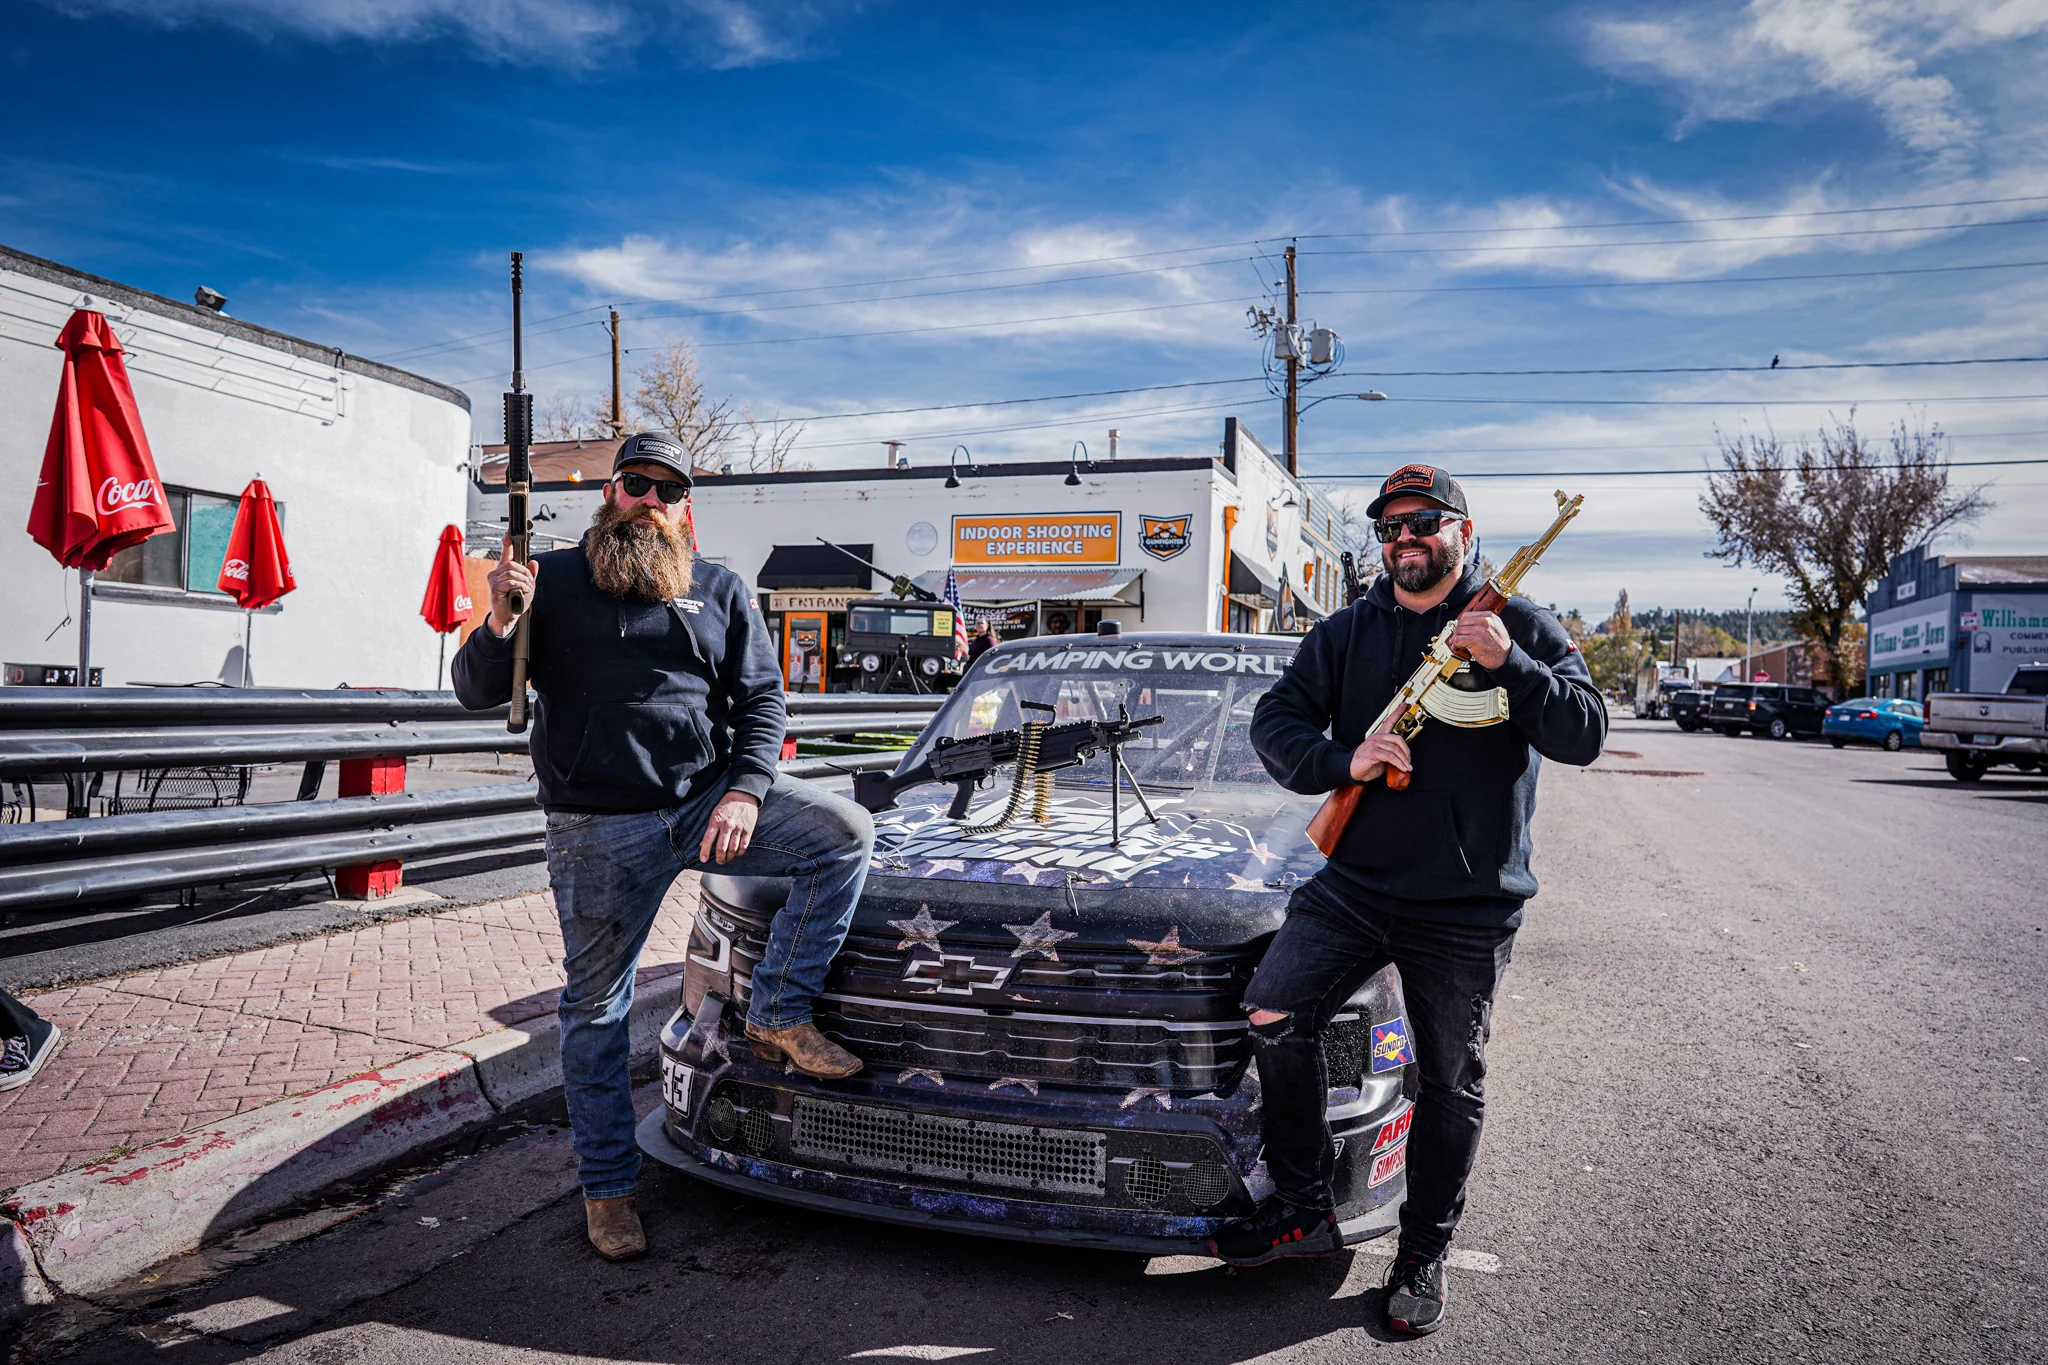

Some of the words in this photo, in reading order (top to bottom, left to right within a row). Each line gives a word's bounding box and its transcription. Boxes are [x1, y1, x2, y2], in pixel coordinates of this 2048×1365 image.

[960, 526, 1022, 540] INDOOR
[1026, 524, 1113, 539] SHOOTING
[986, 541, 1083, 555] EXPERIENCE
[985, 651, 1154, 674] CAMPING
[1161, 651, 1284, 676] WORL
[1375, 1036, 1405, 1056] SUNOCO
[1373, 1144, 1407, 1182] SIMPSO
